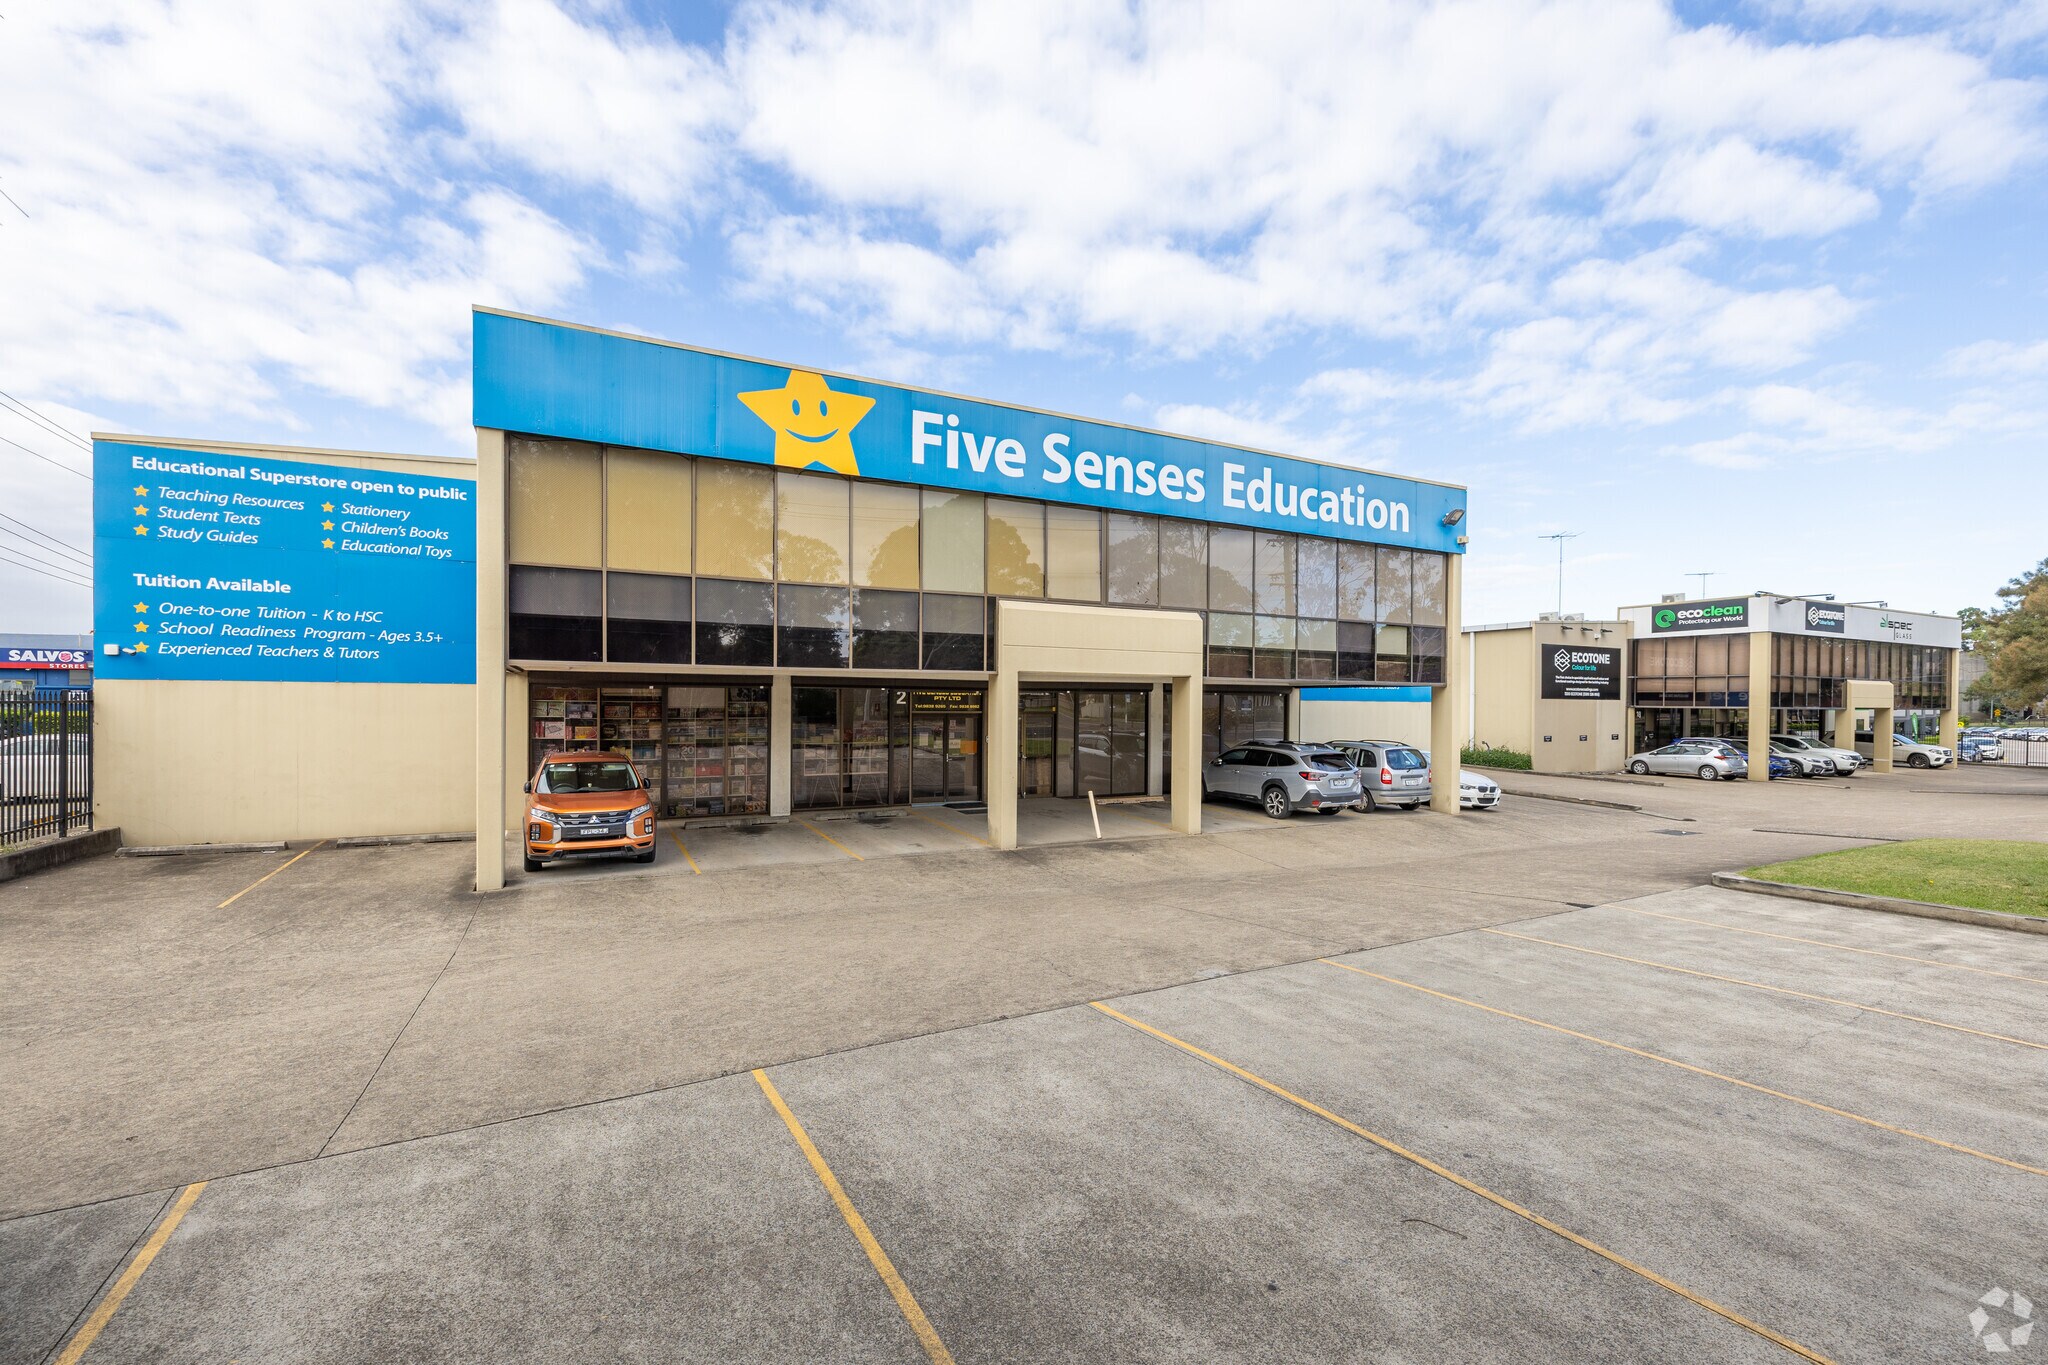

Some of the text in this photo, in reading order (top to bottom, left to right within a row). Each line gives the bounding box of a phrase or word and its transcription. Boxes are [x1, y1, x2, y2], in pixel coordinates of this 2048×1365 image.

[131, 455, 468, 501] Educational Superstore open to public
[911, 409, 1410, 533] Five Senses Education
[158, 485, 305, 511] Teaching Resources
[157, 505, 262, 526] Student Texts
[341, 502, 411, 521] Stationery
[157, 525, 259, 545] Study Guides
[341, 521, 449, 540] Children's Books
[341, 539, 453, 559] Educational Toys
[132, 573, 292, 594] Tuition Available
[158, 602, 251, 618] One-to-one
[257, 606, 306, 620] Tuition
[323, 609, 335, 621] K
[336, 611, 351, 622] to
[354, 610, 383, 623] HSC
[1677, 605, 1743, 618] ecoclean
[158, 621, 214, 636] School
[220, 623, 296, 638] Readiness
[303, 627, 366, 642] Program
[377, 629, 411, 644] Ages
[413, 631, 443, 643] 3.5+
[8, 650, 85, 662] SALVOS
[158, 641, 380, 659] Experienced Teachers & Tutors
[1572, 652, 1610, 664] ECOTONE
[896, 691, 907, 704] 2
